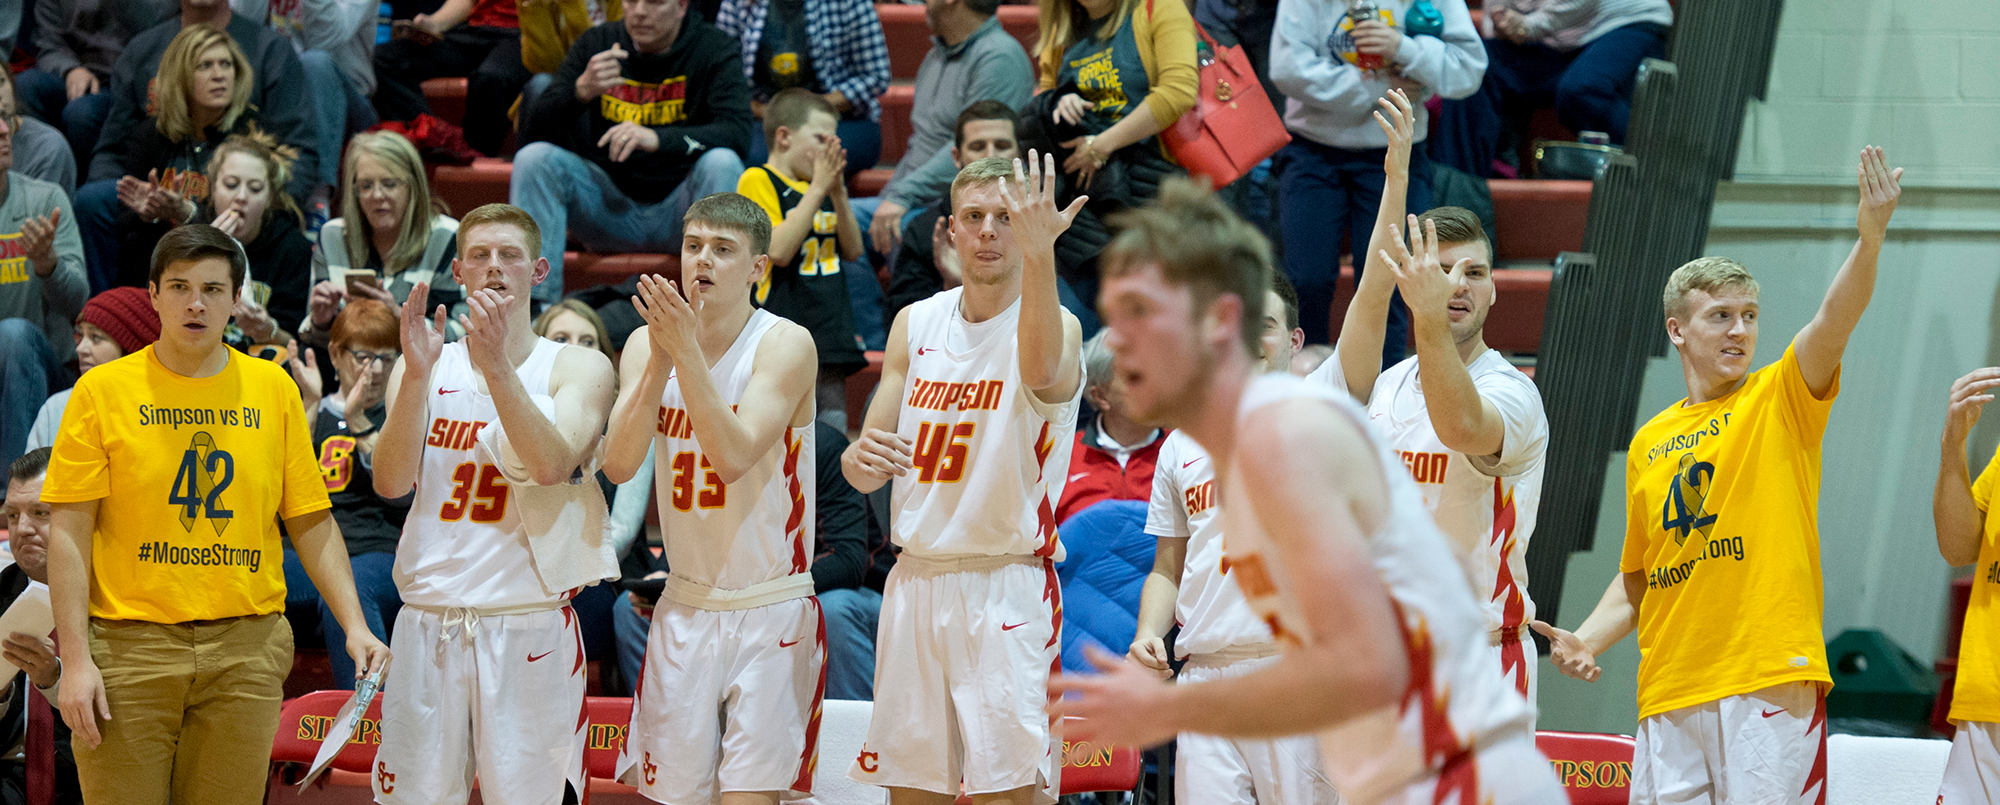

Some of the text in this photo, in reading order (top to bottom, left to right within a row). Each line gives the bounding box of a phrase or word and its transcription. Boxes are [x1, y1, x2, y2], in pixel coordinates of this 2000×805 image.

[139, 404, 261, 430] Simpson vs BV
[318, 435, 356, 493] S
[671, 451, 727, 513] 33
[912, 421, 976, 484] 45
[168, 450, 234, 519] 42
[439, 461, 510, 524] 35
[1662, 461, 1718, 538] 42
[138, 541, 261, 573] #MooseStrong
